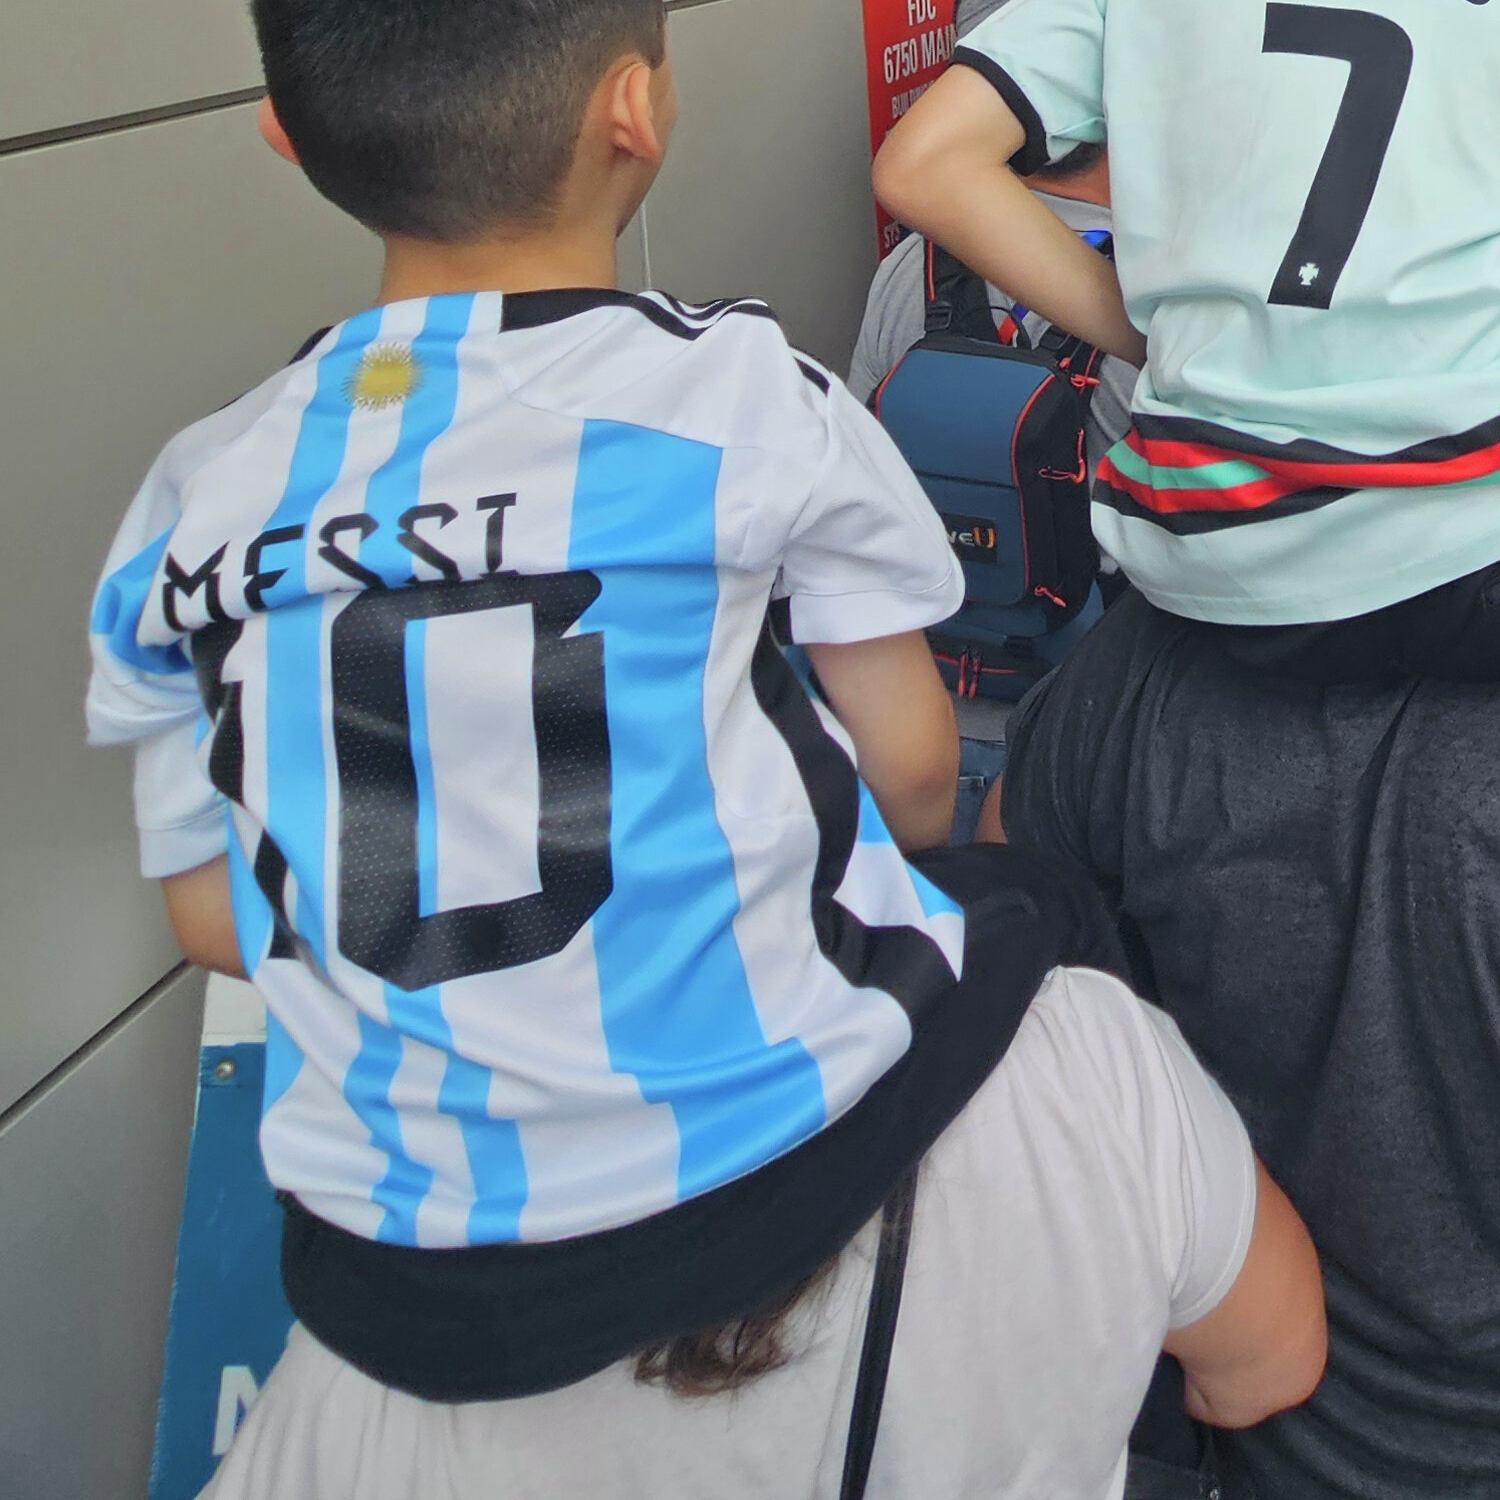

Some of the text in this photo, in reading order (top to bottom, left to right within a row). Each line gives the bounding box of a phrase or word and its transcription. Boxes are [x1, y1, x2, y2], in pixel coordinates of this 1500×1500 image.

[883, 37, 919, 84] 6750
[1261, 2, 1414, 311] 7
[162, 492, 518, 633] MESSI
[190, 569, 615, 992] 10
